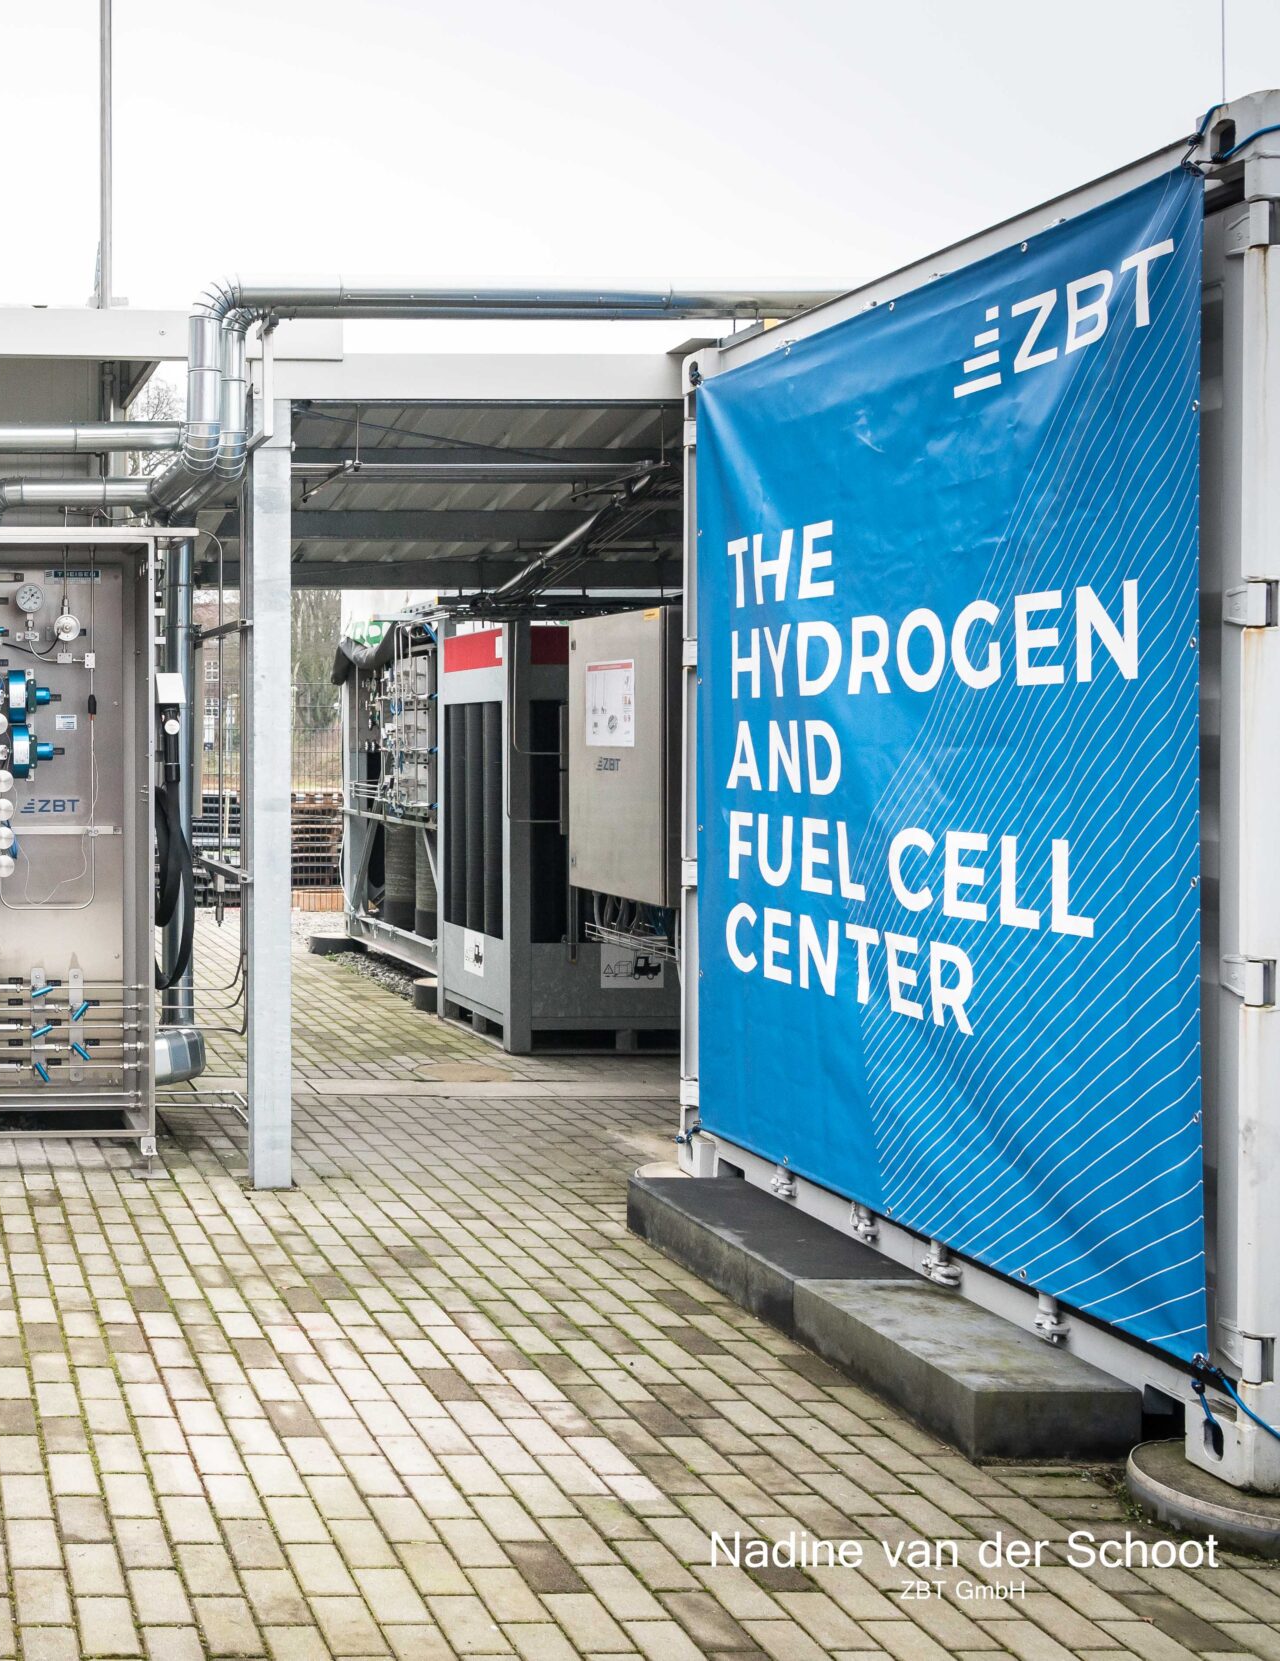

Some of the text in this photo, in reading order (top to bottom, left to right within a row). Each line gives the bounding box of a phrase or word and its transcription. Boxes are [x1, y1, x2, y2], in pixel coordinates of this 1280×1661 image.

[1012, 238, 1175, 373] ZBT
[727, 520, 835, 608] THE
[730, 578, 1140, 699] HYDROGEN
[37, 799, 80, 812] ZBT
[603, 757, 621, 771] ZBT
[726, 719, 842, 795] AND
[727, 812, 1095, 939] FUEL CELL
[726, 901, 975, 1036] CENTER
